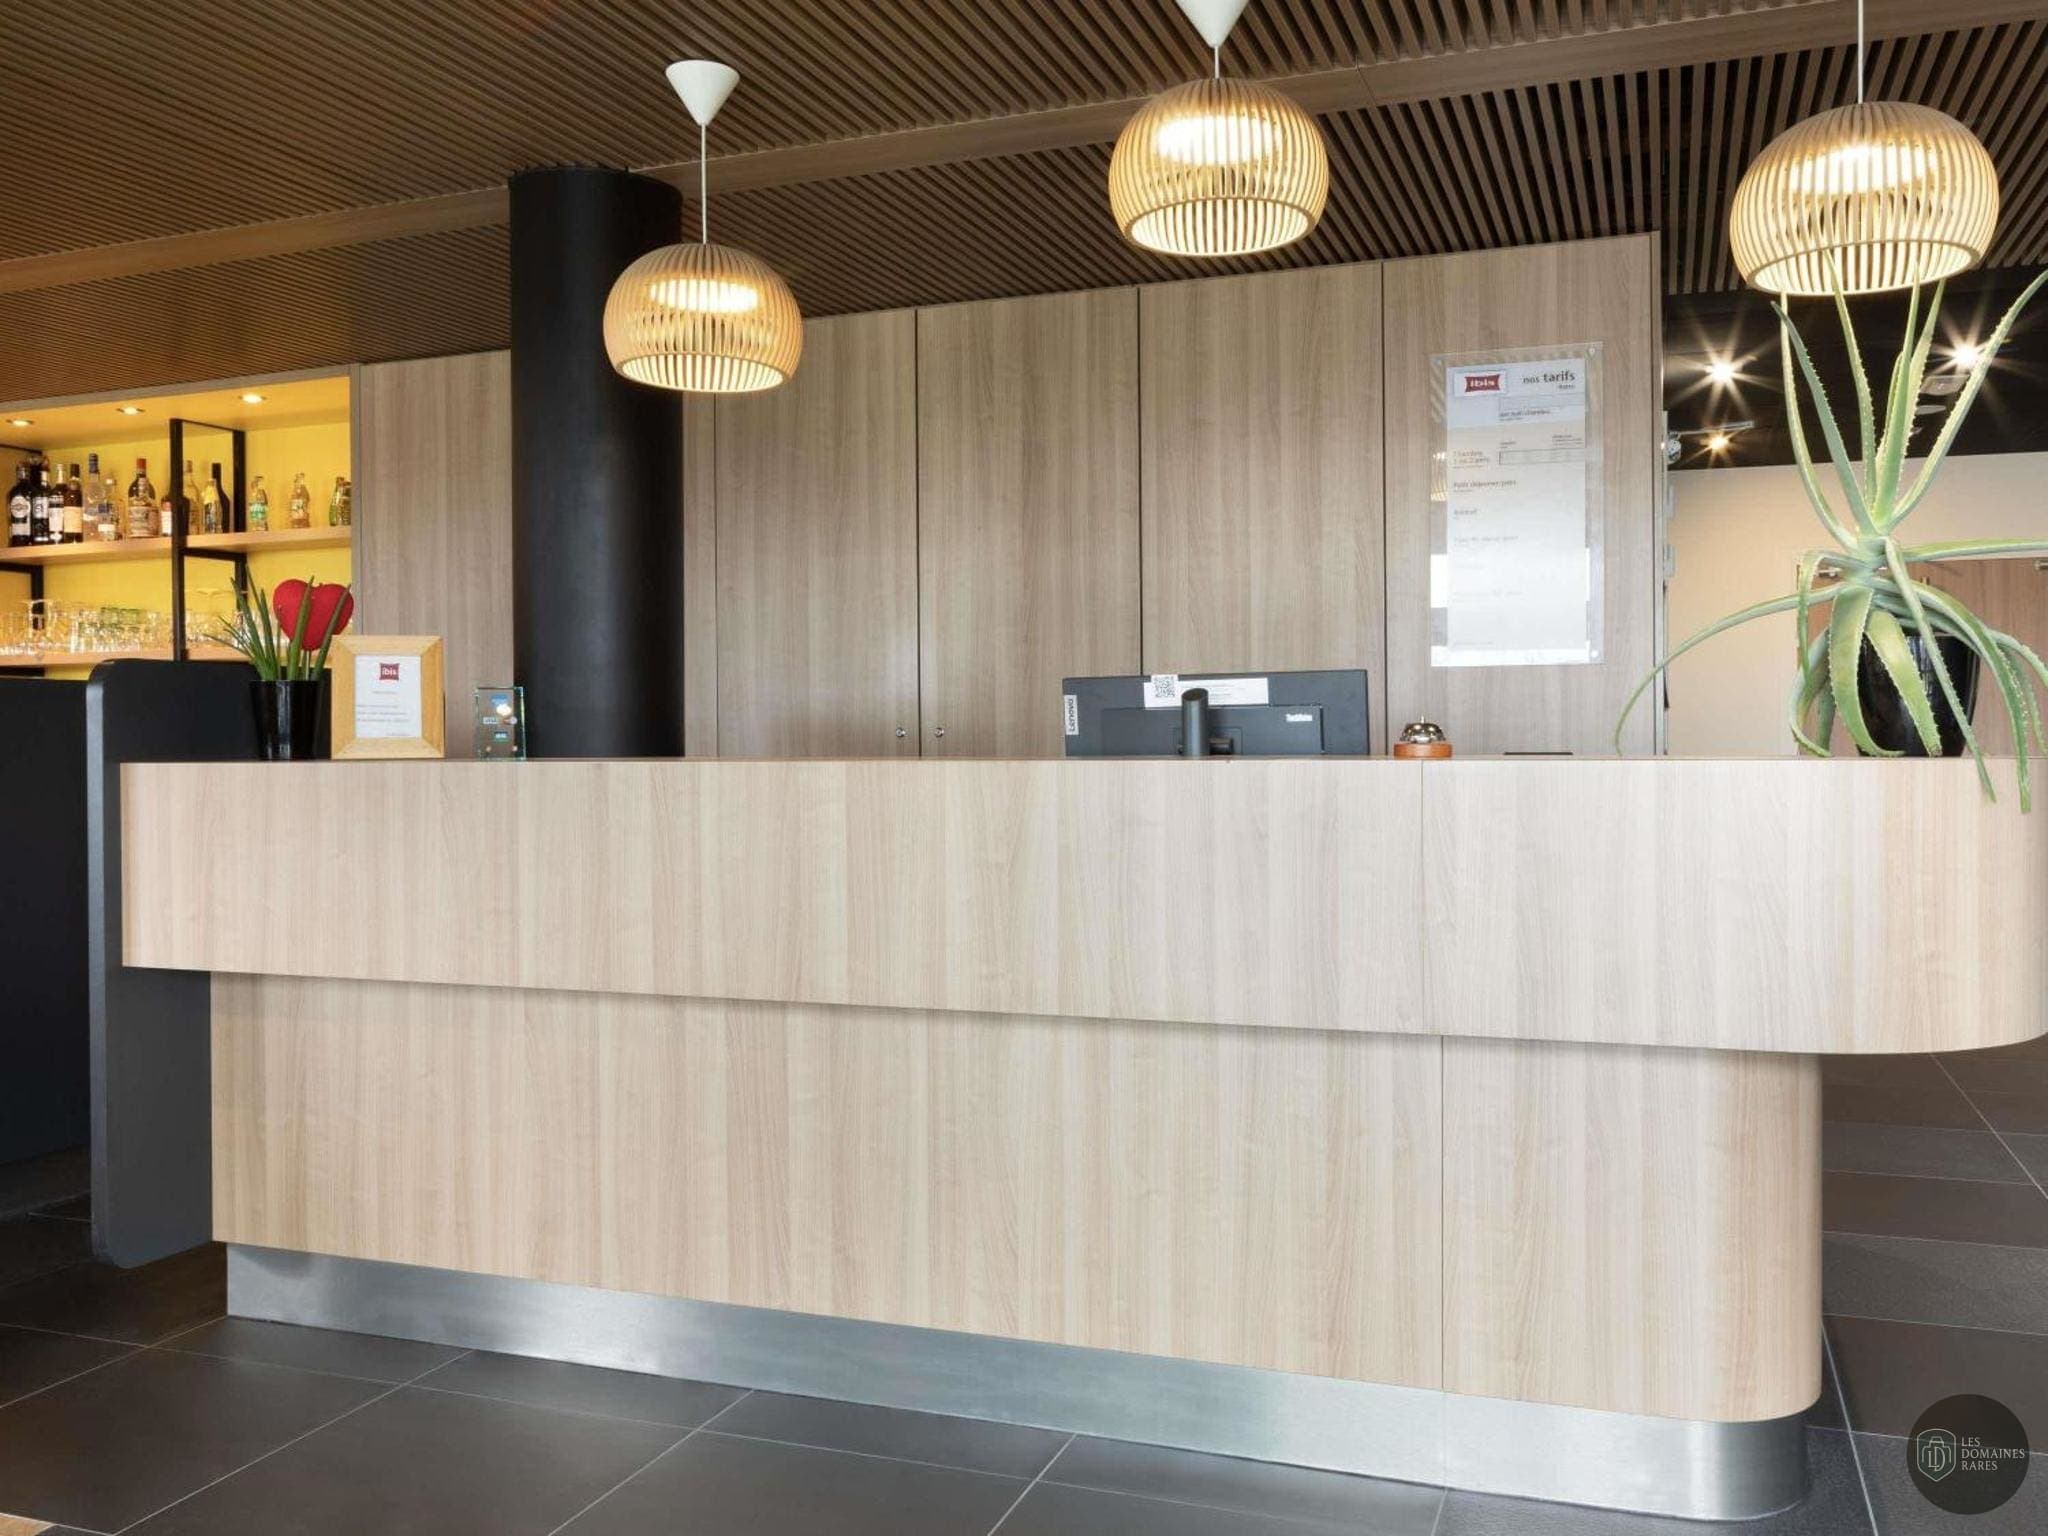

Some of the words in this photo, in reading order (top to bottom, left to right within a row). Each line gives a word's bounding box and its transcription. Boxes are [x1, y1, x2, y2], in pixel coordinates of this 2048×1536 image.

[1523, 376, 1540, 384] nos
[1543, 369, 1576, 382] tarifs
[1470, 378, 1496, 387] ibis
[382, 667, 397, 675] ibis
